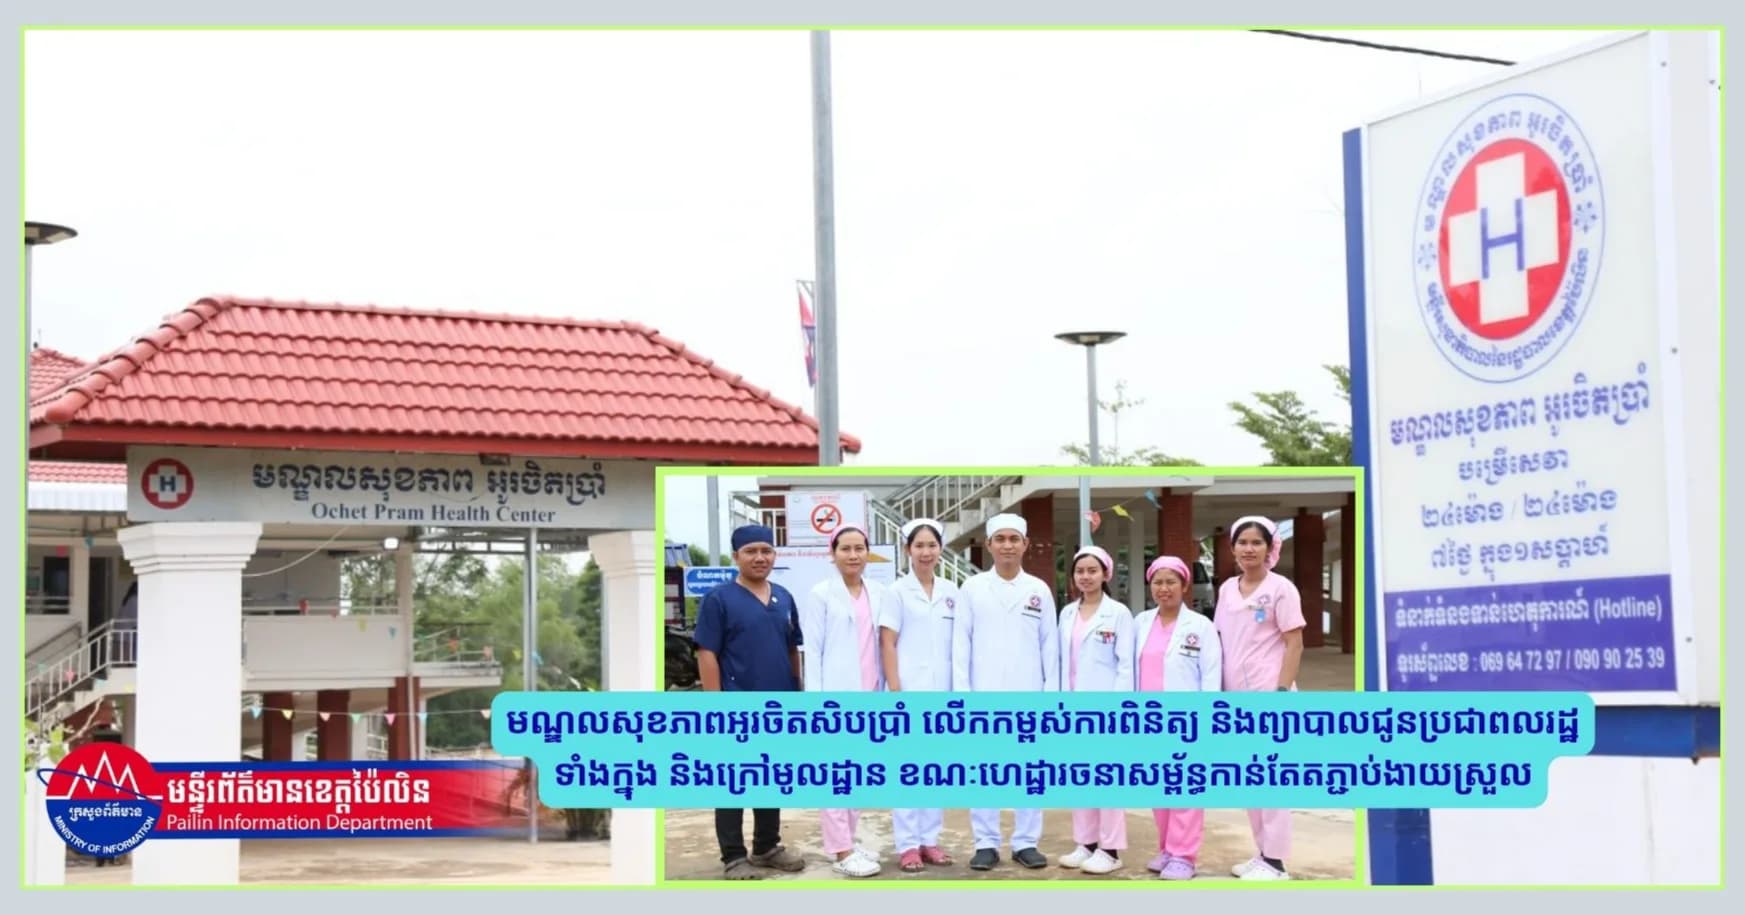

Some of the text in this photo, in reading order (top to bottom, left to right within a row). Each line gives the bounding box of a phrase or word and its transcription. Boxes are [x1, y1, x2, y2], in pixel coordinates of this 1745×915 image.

[1480, 197, 1525, 280] H
[1390, 397, 1537, 456] មណ្ឌលសុខភាព
[159, 475, 177, 492] H
[252, 459, 606, 506] មណ្ឌលសុខភាព អូរចិតប្រាំ
[311, 502, 556, 523] Ochet Pram Health Center
[1594, 595, 1663, 624] (Hotline)
[1480, 652, 1503, 672] 069
[1506, 651, 1523, 671] 64
[1526, 650, 1543, 670] 72
[1546, 650, 1561, 670] 97
[1574, 649, 1600, 670] 090
[1603, 649, 1621, 669] 90
[1625, 648, 1644, 669] 25
[1647, 647, 1665, 668] 39
